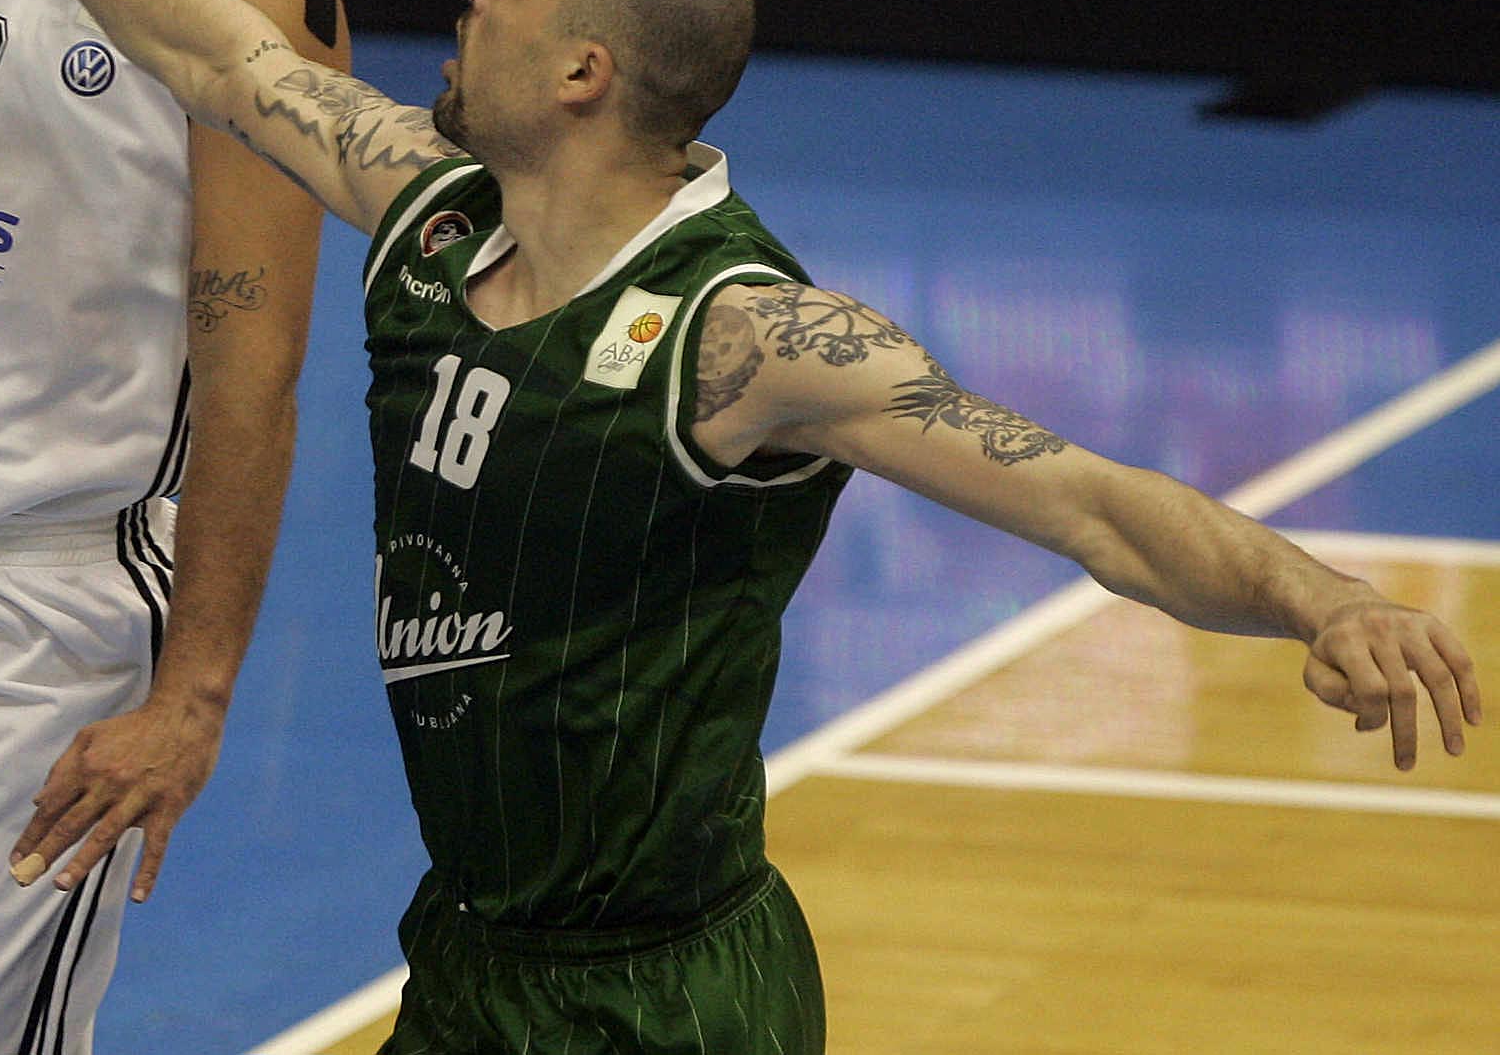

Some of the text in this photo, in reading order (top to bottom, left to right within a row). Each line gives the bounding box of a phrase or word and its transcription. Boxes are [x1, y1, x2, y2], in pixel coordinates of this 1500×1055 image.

[597, 341, 646, 366] ABA
[409, 353, 511, 490] 18
[389, 533, 469, 594] PIVOVARNA
